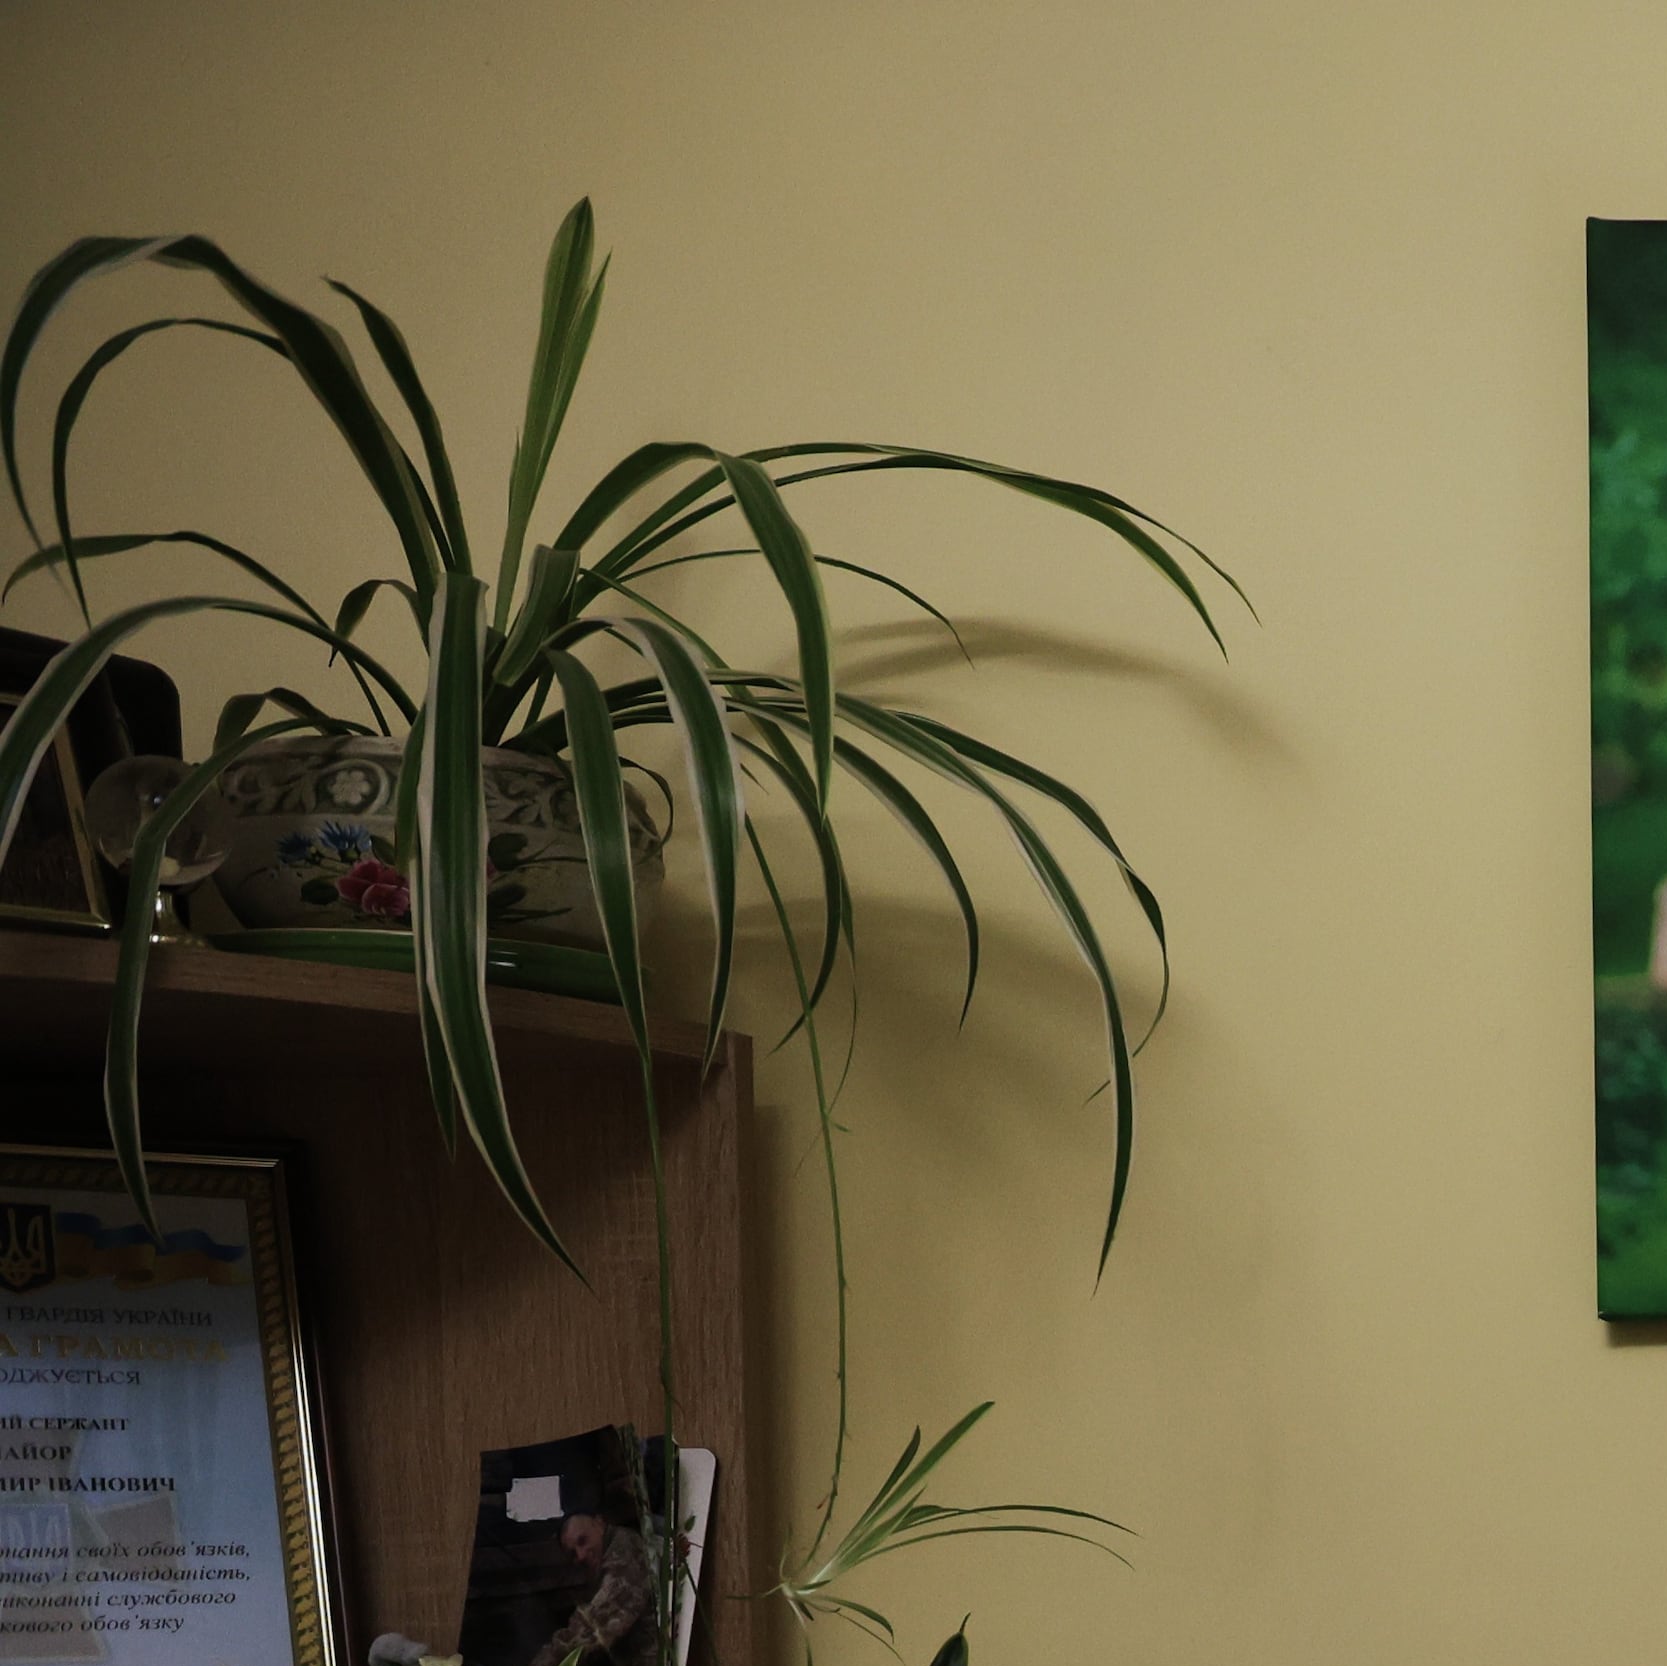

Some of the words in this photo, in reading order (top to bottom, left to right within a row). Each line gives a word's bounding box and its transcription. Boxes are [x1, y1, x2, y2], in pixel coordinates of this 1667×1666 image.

[6, 1305, 106, 1325] ГВАРДІЯ
[112, 1307, 214, 1327] УКРАЇНИ
[29, 1334, 230, 1361] ГРАМОТА
[28, 1415, 130, 1432] СЕРЖАНТ
[0, 1442, 72, 1461] АЙОР
[49, 1476, 176, 1493] ІВАНОВИЧ
[76, 1543, 130, 1559] своїх
[75, 1565, 251, 1583] самовідданість,
[0, 1591, 100, 1609] иконанні
[106, 1588, 237, 1611] службового
[80, 1614, 185, 1634] обов'язку
